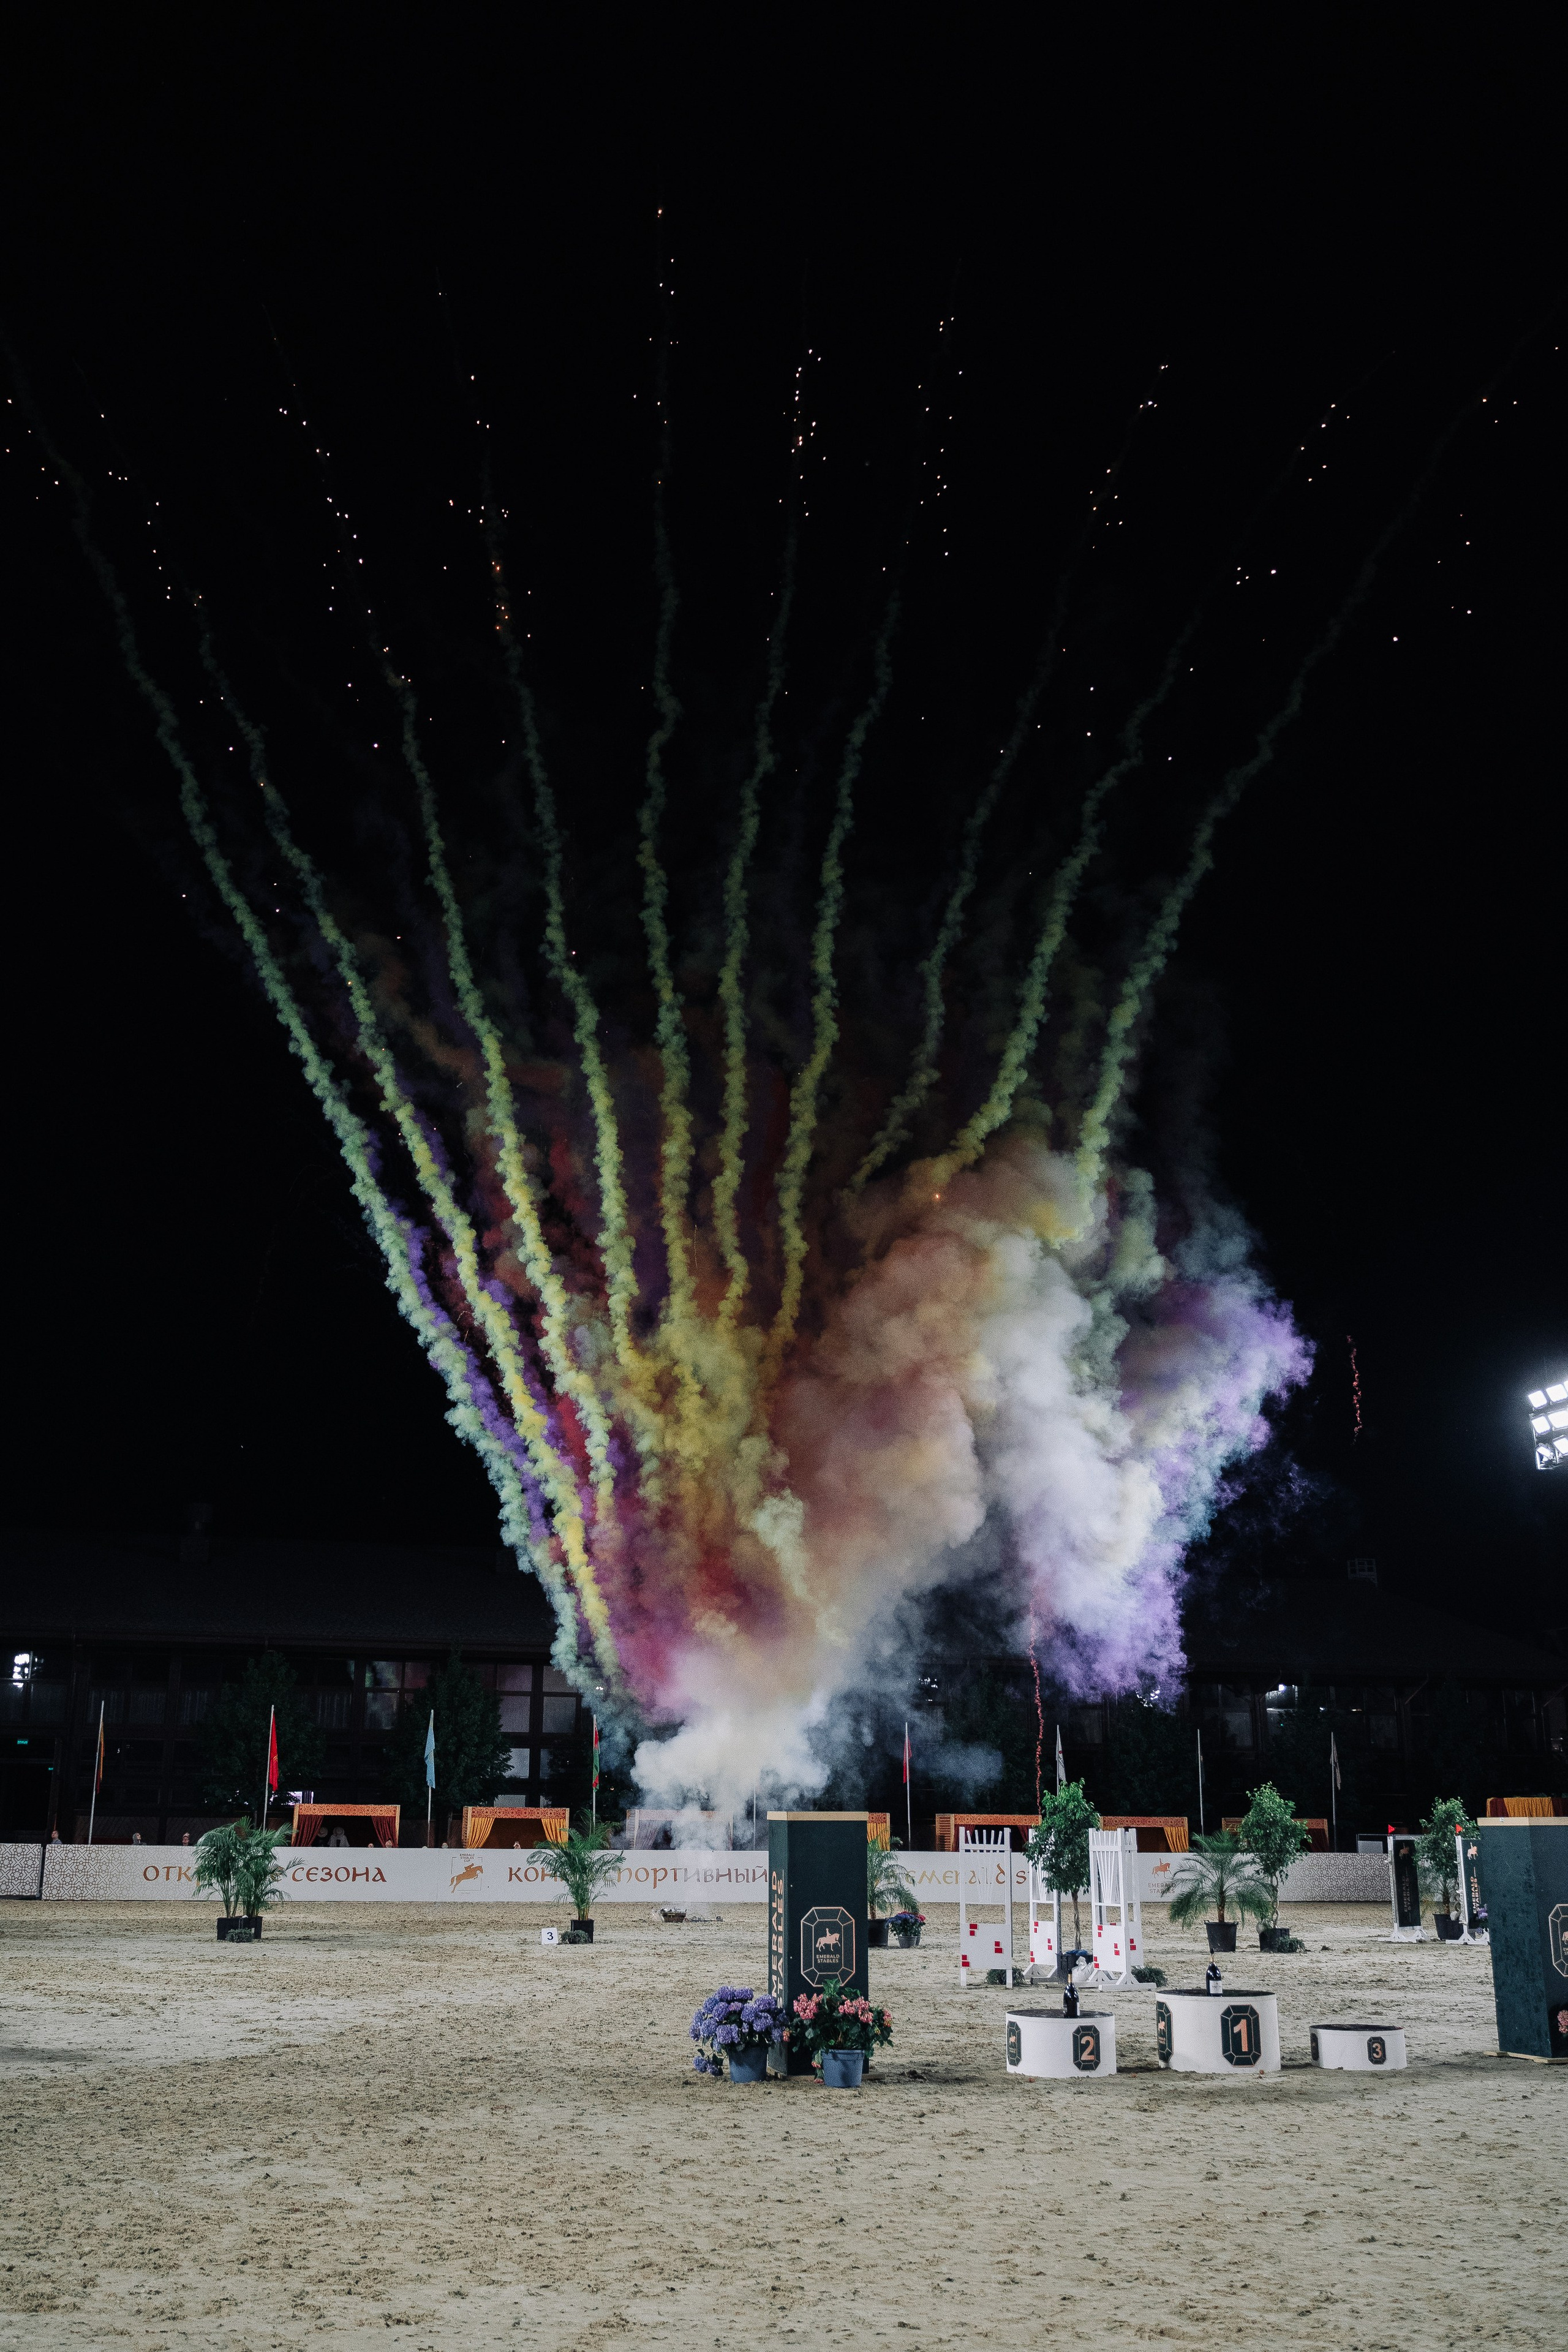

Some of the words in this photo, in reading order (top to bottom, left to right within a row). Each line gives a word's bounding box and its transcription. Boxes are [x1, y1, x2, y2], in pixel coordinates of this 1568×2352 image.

[292, 1866, 387, 1882] СЕЗОНА
[546, 1931, 554, 1940] 3
[1233, 2019, 1248, 2052] 1
[1080, 2035, 1095, 2061] 2
[1372, 2043, 1382, 2059] 3
